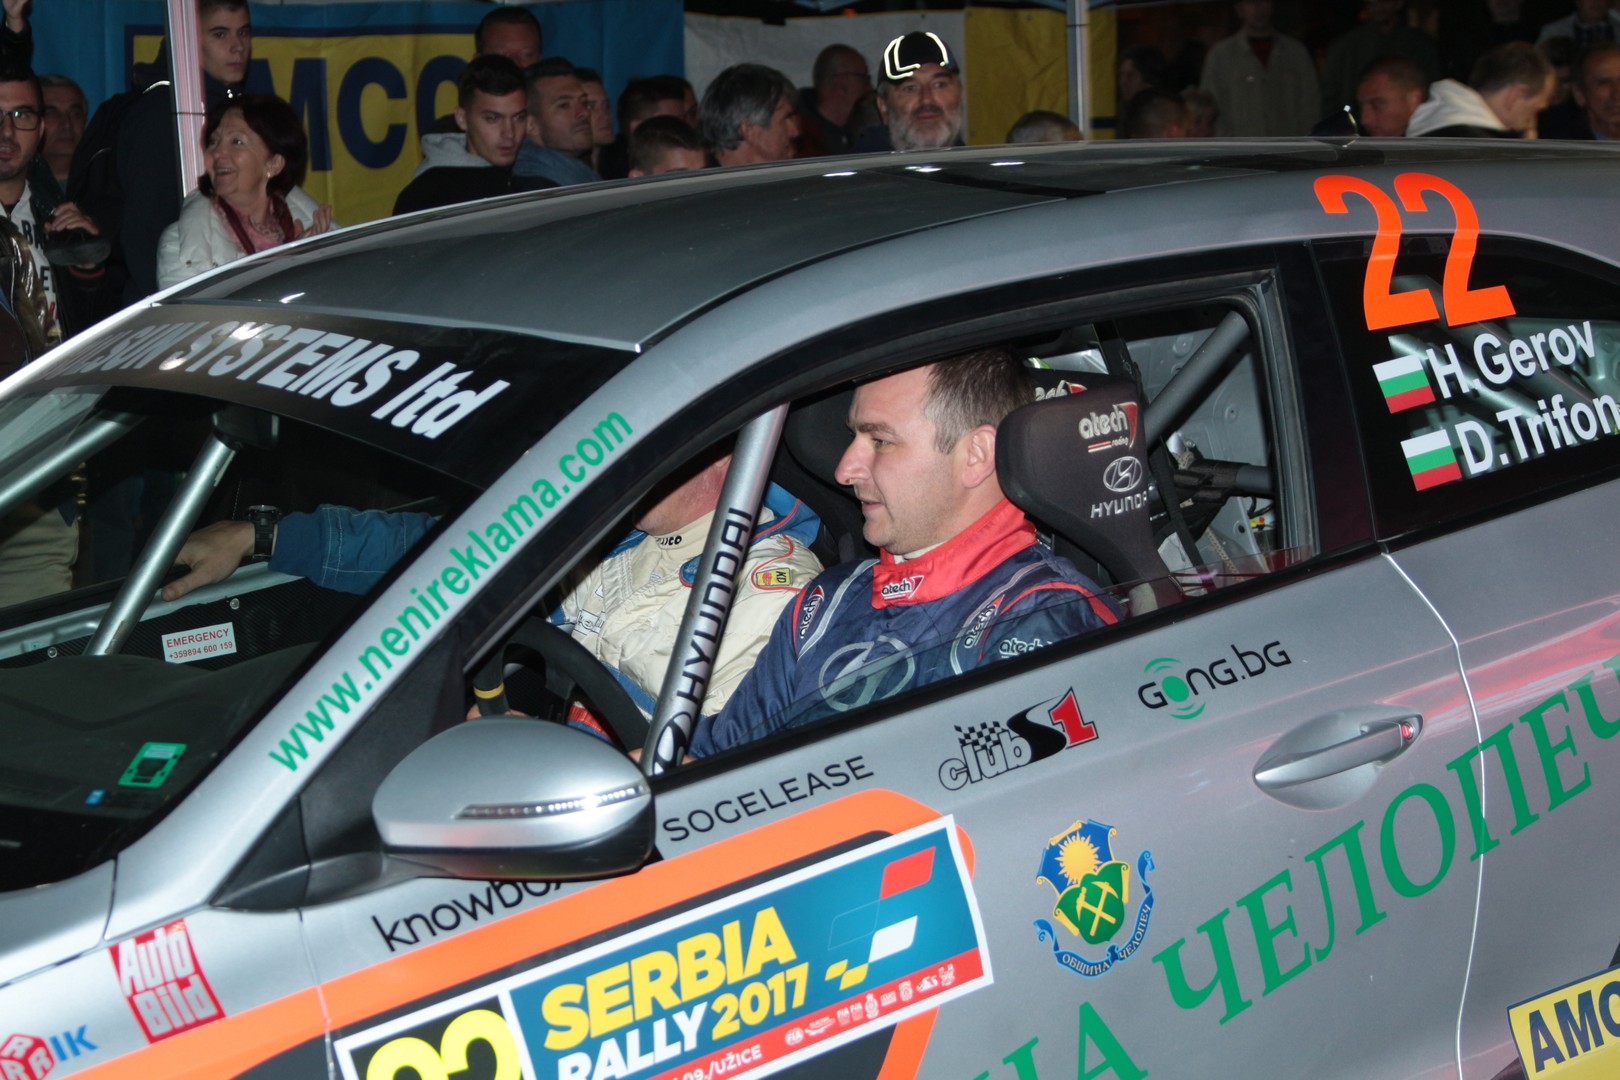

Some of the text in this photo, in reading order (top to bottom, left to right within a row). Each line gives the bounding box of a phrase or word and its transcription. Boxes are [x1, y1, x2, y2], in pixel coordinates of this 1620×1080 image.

[1313, 172, 1516, 331] 22
[158, 320, 421, 408] SYSTEMS
[370, 361, 511, 440] ltd
[1426, 320, 1596, 399] H.Gerov
[1078, 404, 1129, 440] atech
[1090, 491, 1148, 519] HYUNDA
[268, 411, 634, 772] www.nenireklama.com
[676, 508, 753, 704] HYUNDAI
[799, 595, 822, 640] atech
[881, 577, 913, 597] atech
[166, 628, 230, 648] EMERGENCY
[169, 641, 233, 659] +359894 600 159
[963, 601, 998, 649] atech
[662, 755, 874, 843] SOGELEASE
[118, 925, 197, 998] Auto
[1061, 903, 1152, 975] ОБЩИНА ЧЕЛОПЕЧ
[131, 973, 219, 1038] Bild
[541, 906, 798, 1051] SERBIA
[557, 1001, 708, 1080] RALLY
[710, 961, 809, 1041] 2017
